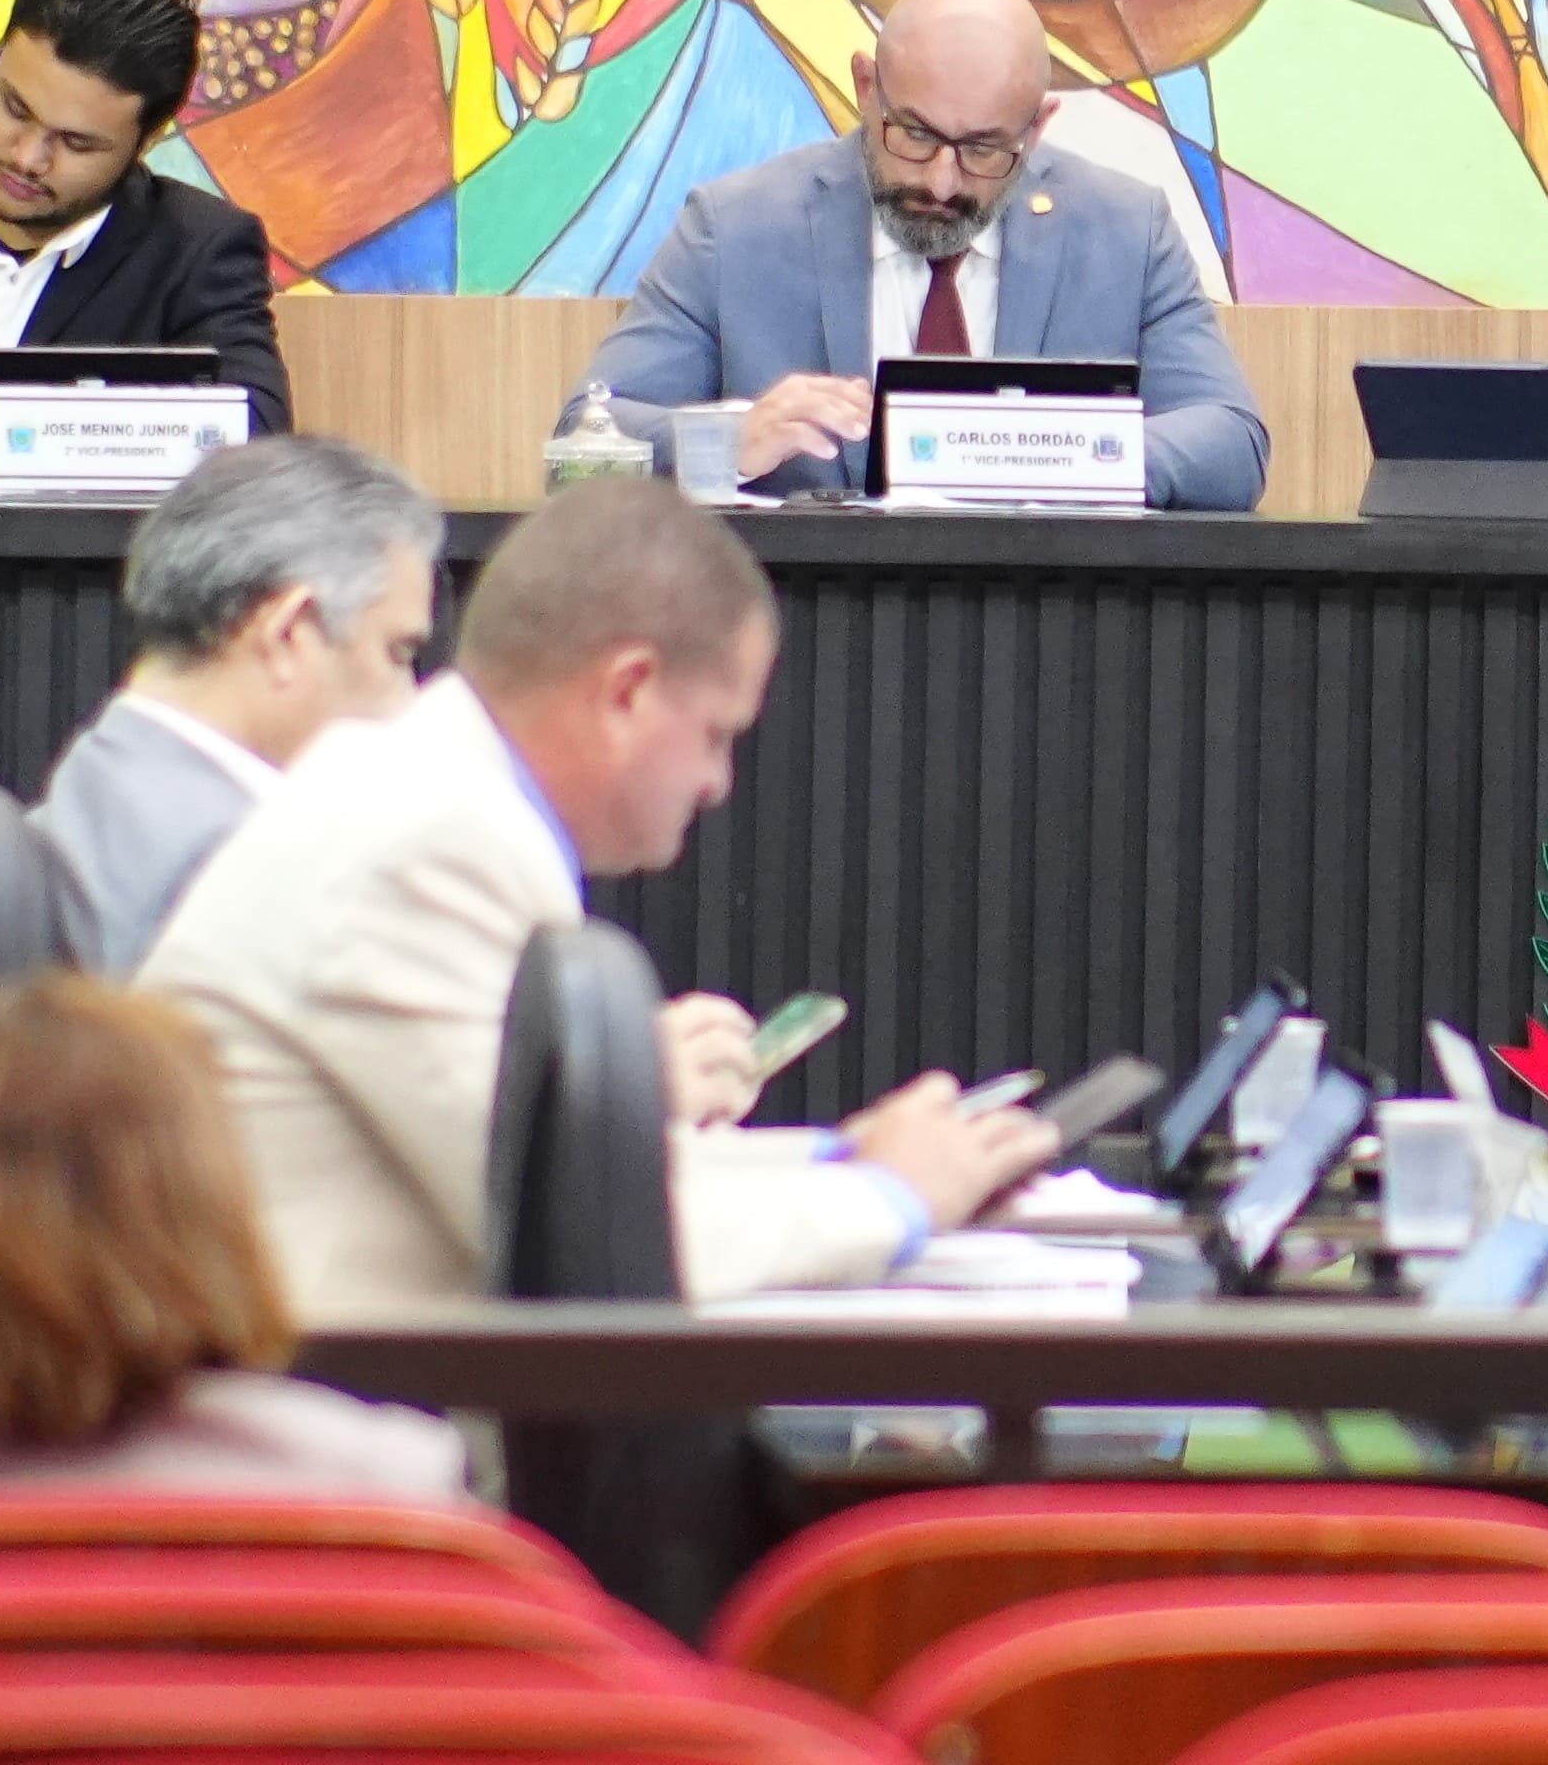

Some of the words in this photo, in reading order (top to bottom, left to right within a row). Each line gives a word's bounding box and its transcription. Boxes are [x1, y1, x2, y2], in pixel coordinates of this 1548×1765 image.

[81, 423, 134, 437] MENINO
[946, 431, 1012, 446] CARLOS
[975, 455, 1075, 468] VICE-PRESIDENTE
